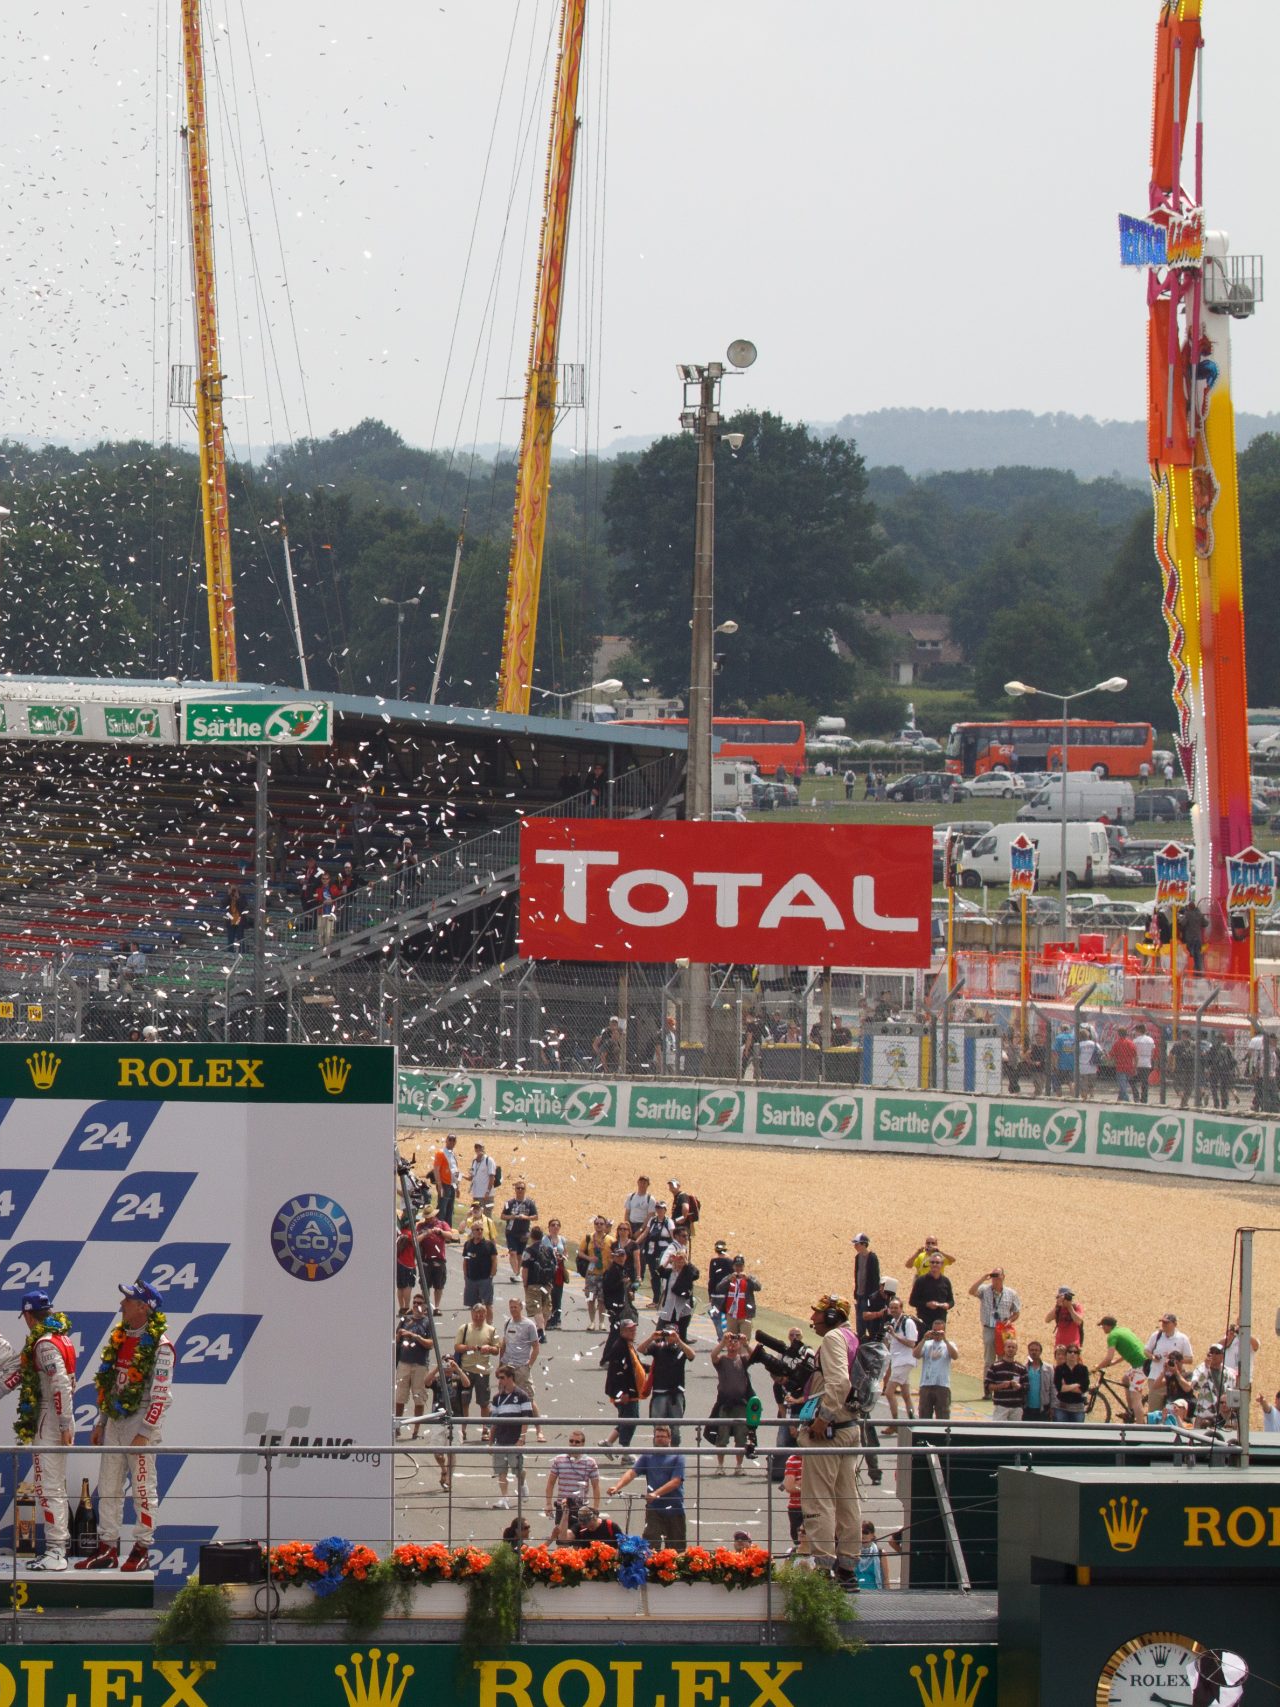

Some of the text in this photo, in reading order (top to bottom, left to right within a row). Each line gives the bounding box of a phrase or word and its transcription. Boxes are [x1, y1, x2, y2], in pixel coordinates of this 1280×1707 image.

[193, 717, 262, 737] Sarthe
[536, 849, 919, 932] TOTAL
[118, 1058, 265, 1088] ROLEX
[502, 1091, 562, 1116] Sarthe
[635, 1097, 692, 1121] Sarthe
[762, 1104, 815, 1128] Sarthe
[879, 1109, 930, 1134] Sarthe
[994, 1115, 1041, 1139] Sarthe
[78, 1122, 132, 1151] 24
[1102, 1122, 1146, 1148] Sarthe
[1195, 1131, 1231, 1158] Sarthe
[111, 1192, 164, 1222] 24
[1, 1261, 54, 1291] 24
[150, 1263, 199, 1291] 24
[180, 1334, 233, 1364] 24
[148, 1403, 163, 1424] TDI
[33, 1483, 48, 1508] Audi
[137, 1486, 150, 1511] Audi
[10, 1580, 29, 1605] 3
[477, 1659, 804, 1707] ROLEX
[1130, 1674, 1191, 1687] ROLEX
